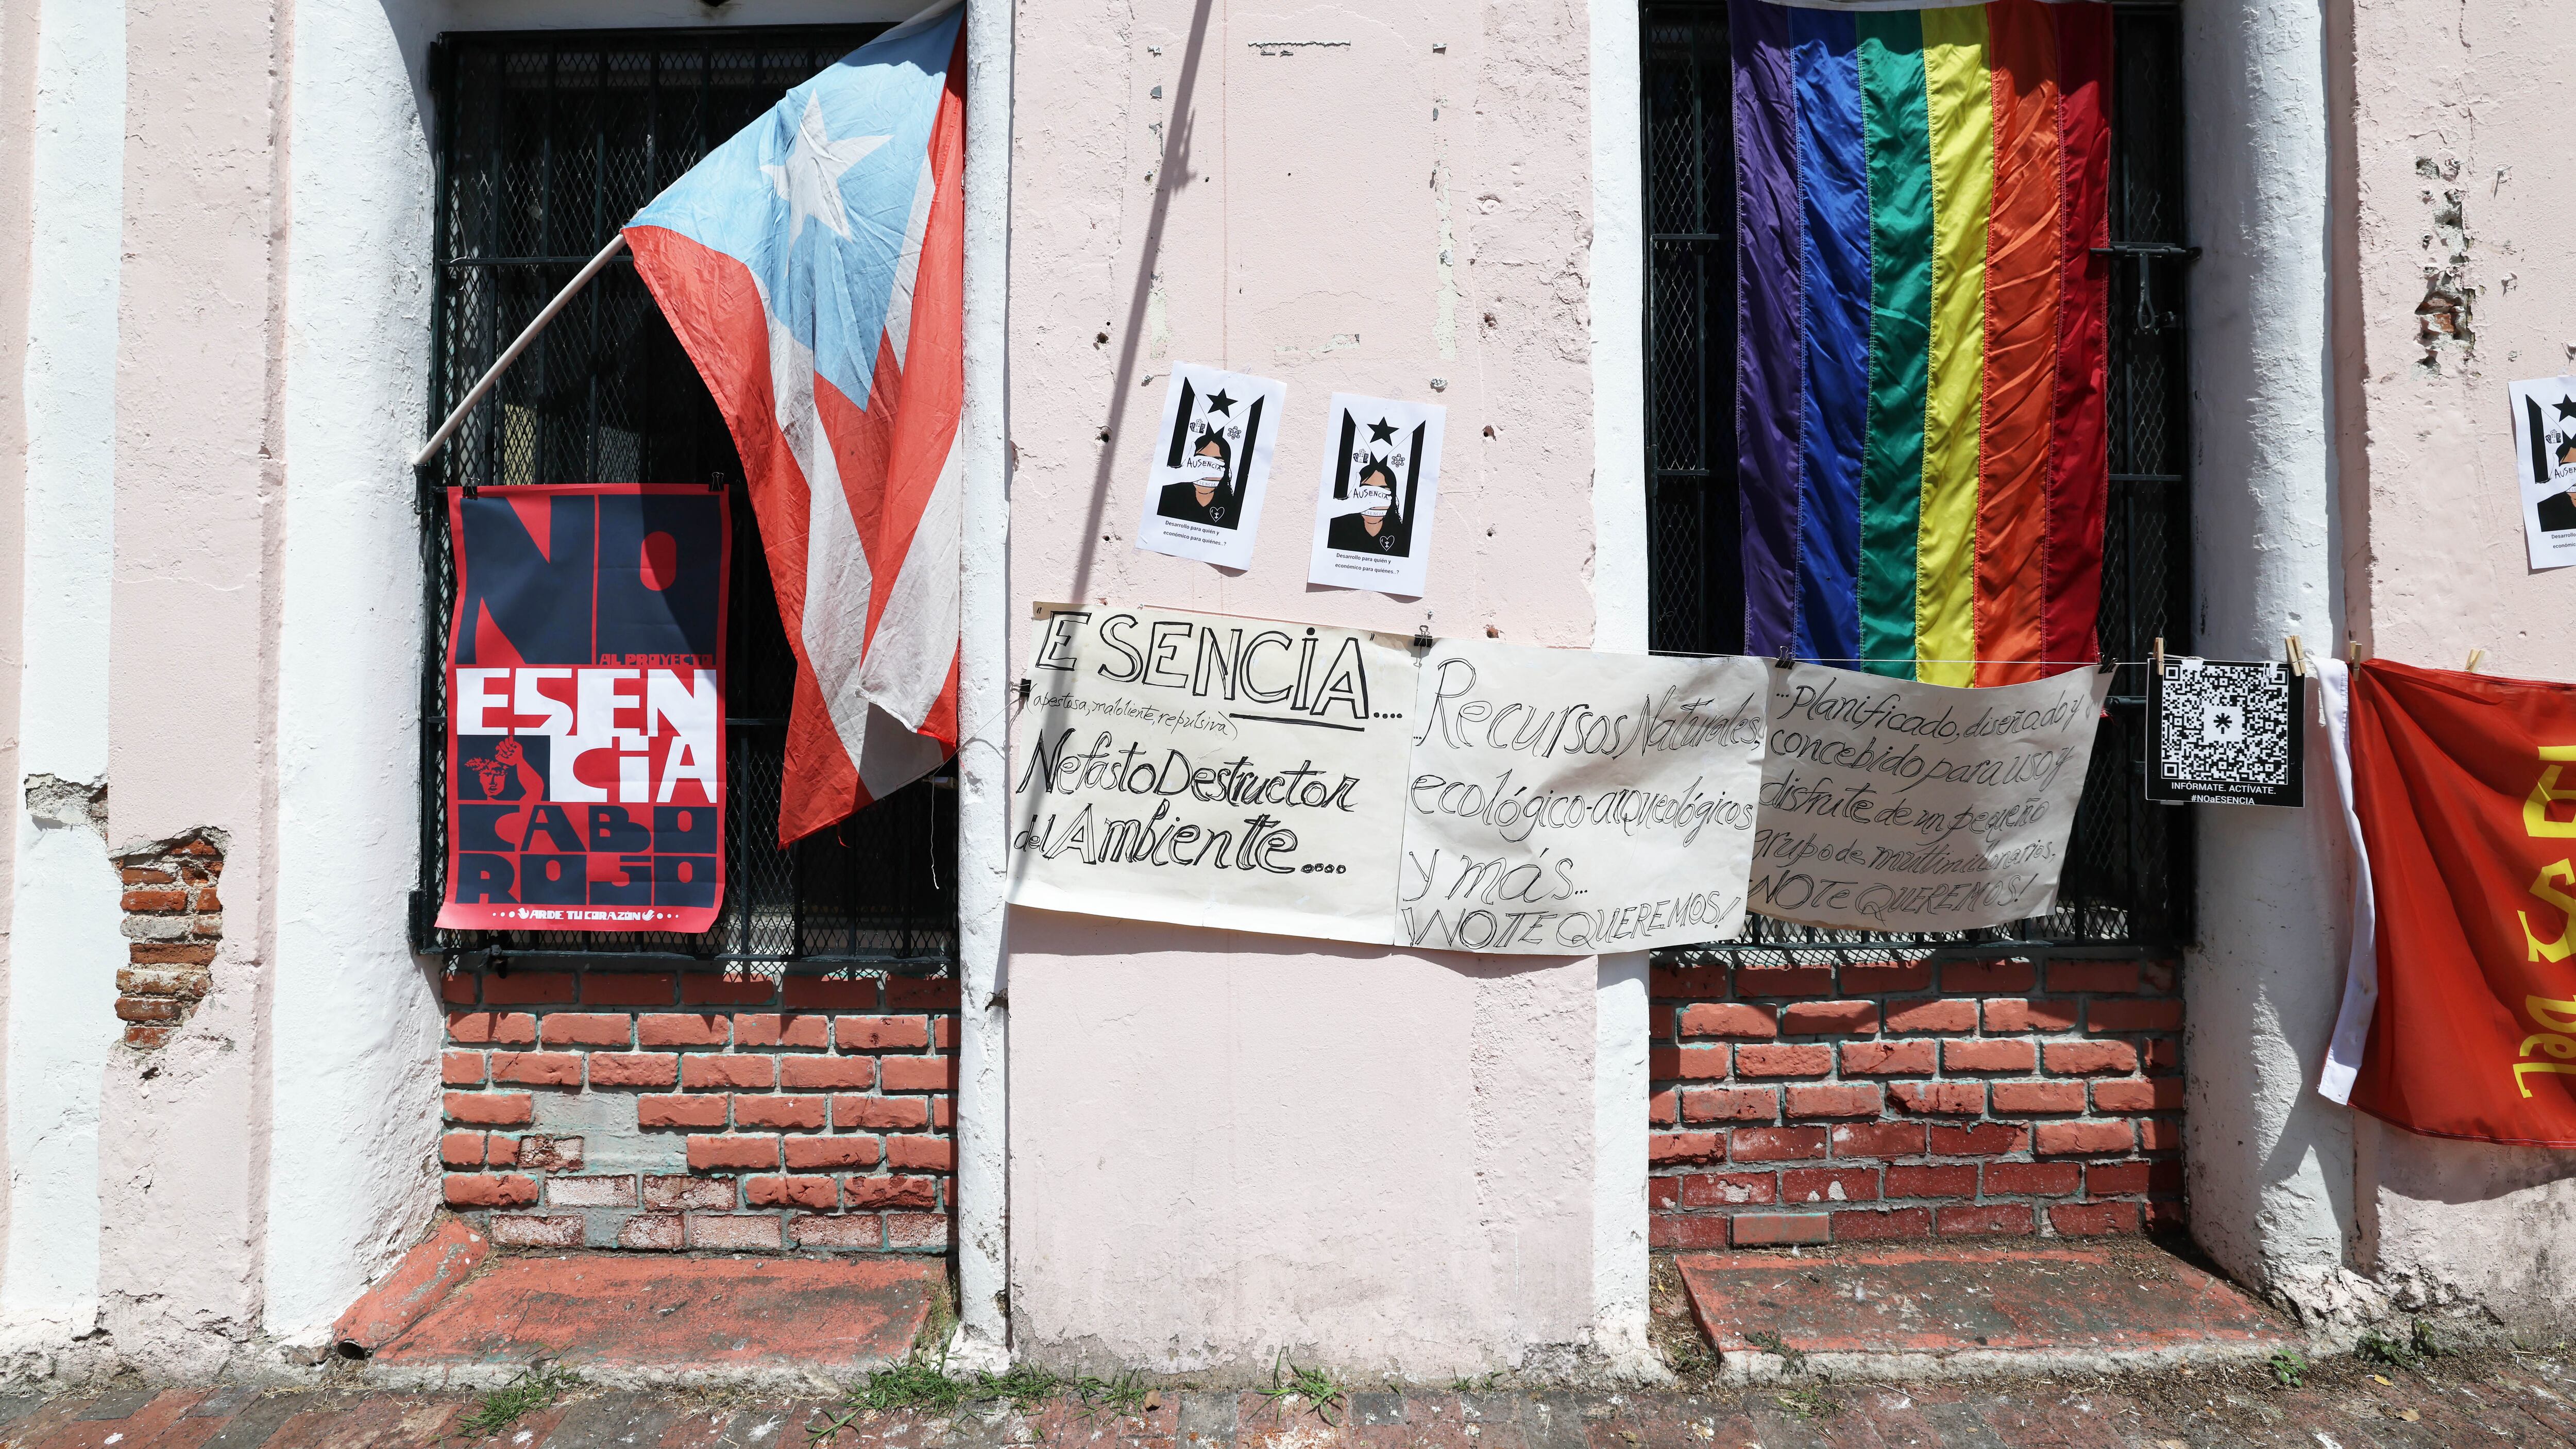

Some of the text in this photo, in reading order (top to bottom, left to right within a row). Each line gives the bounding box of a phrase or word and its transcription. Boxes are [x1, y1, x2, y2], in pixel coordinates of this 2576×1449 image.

[1187, 457, 1222, 471] AUSENCIA
[1353, 487, 1389, 500] AUSENCIA
[1165, 520, 1190, 529] Desarrollo
[1163, 530, 1190, 539] económico
[455, 494, 720, 665] NO
[599, 653, 713, 665] AL PROYECTO
[455, 668, 717, 737] ESEN
[1770, 729, 1925, 778] concebido
[2171, 781, 2277, 795] INFÓRMATE. ACTÍVATE.
[2191, 795, 2255, 805] #NOaESENCIA
[458, 805, 717, 854] CABO
[529, 909, 641, 921] ARDE TU CORAZÓN
[1556, 890, 1741, 950] QUEREMOS!
